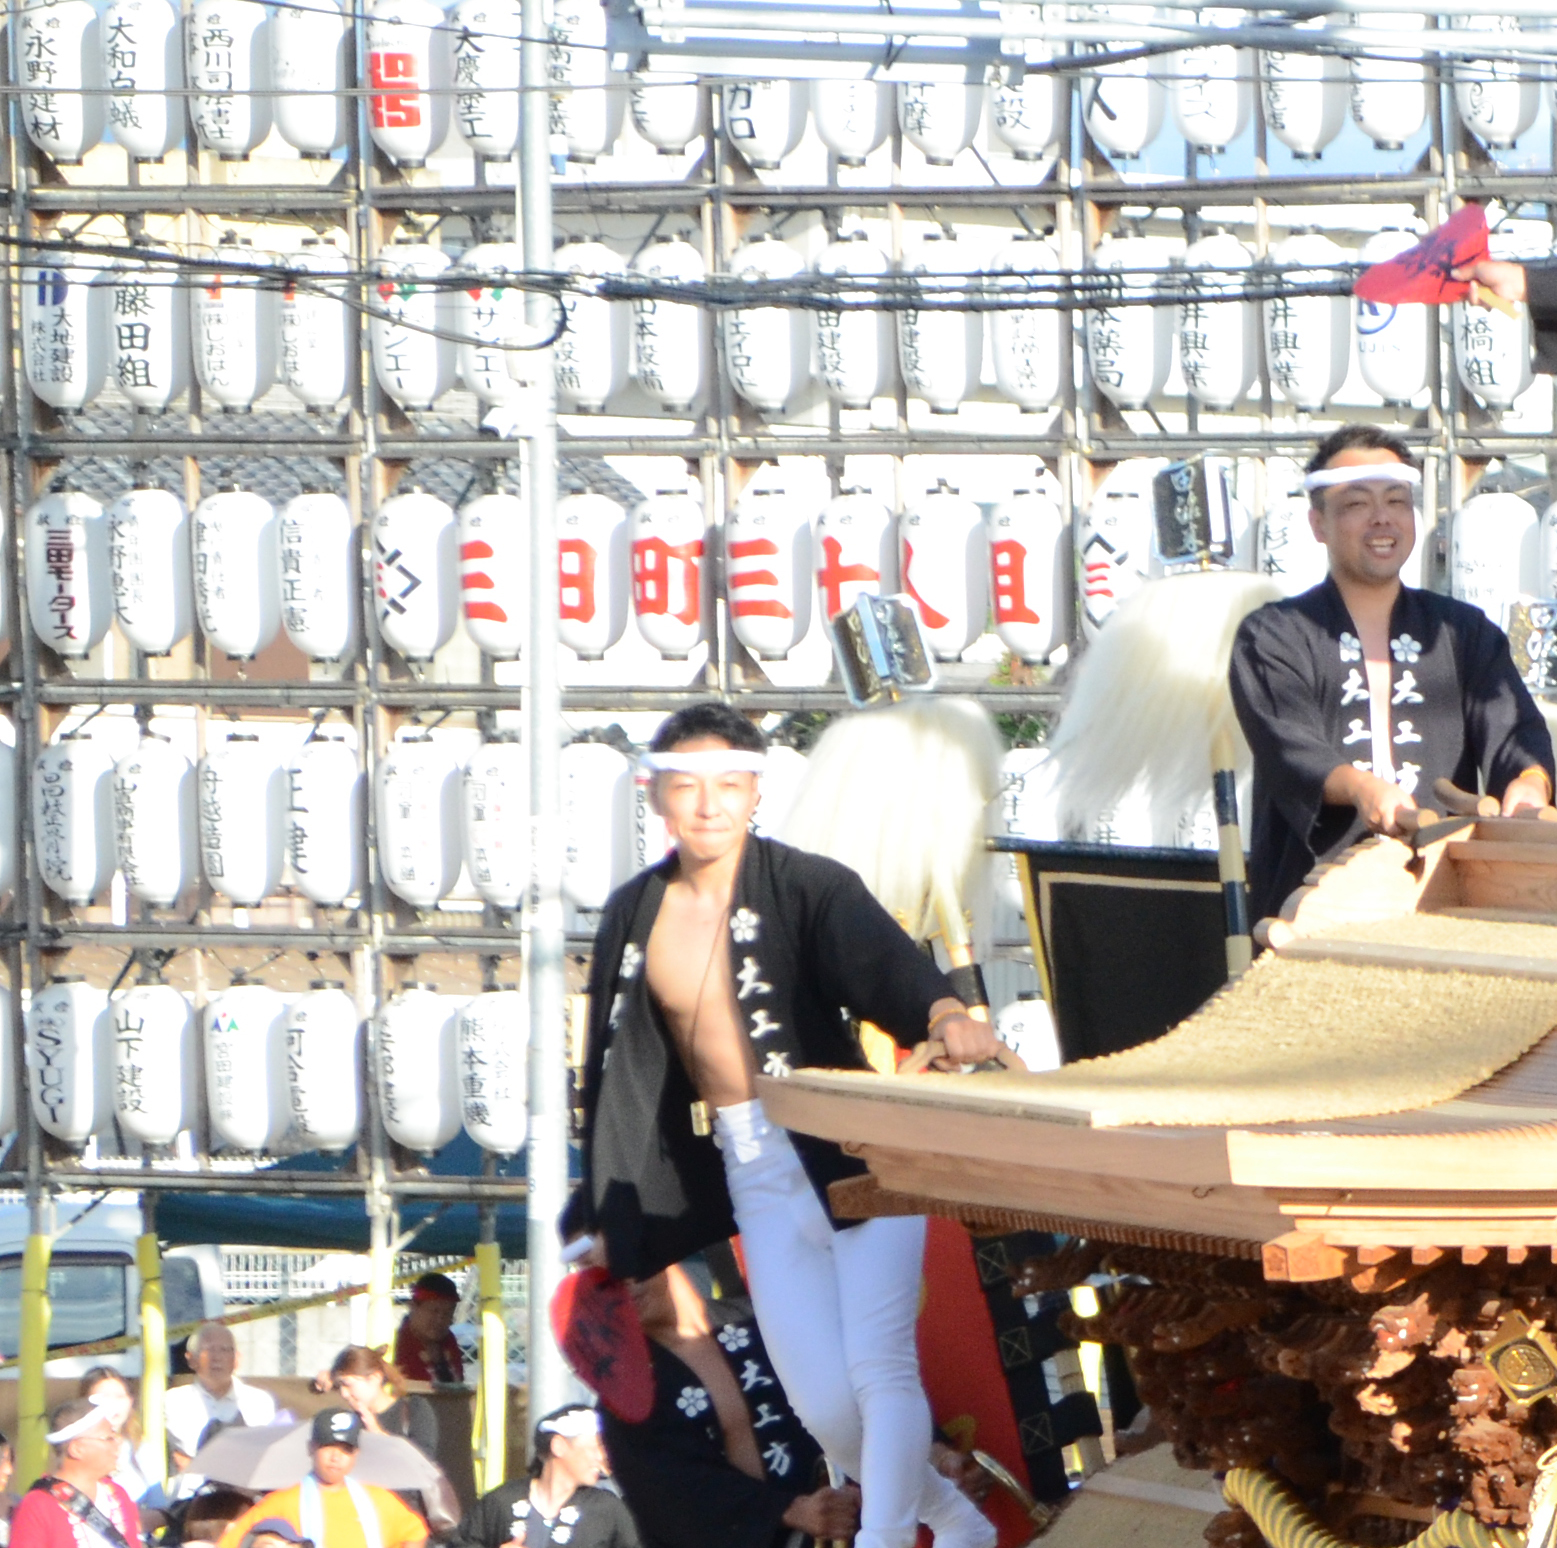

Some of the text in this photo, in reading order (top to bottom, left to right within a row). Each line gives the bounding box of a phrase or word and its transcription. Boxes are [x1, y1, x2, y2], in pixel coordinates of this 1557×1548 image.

[51, 306, 74, 384] 大地建設
[114, 284, 158, 389] 藤田組
[46, 529, 78, 642] 三田モータース
[115, 1008, 149, 1115] 山下建設
